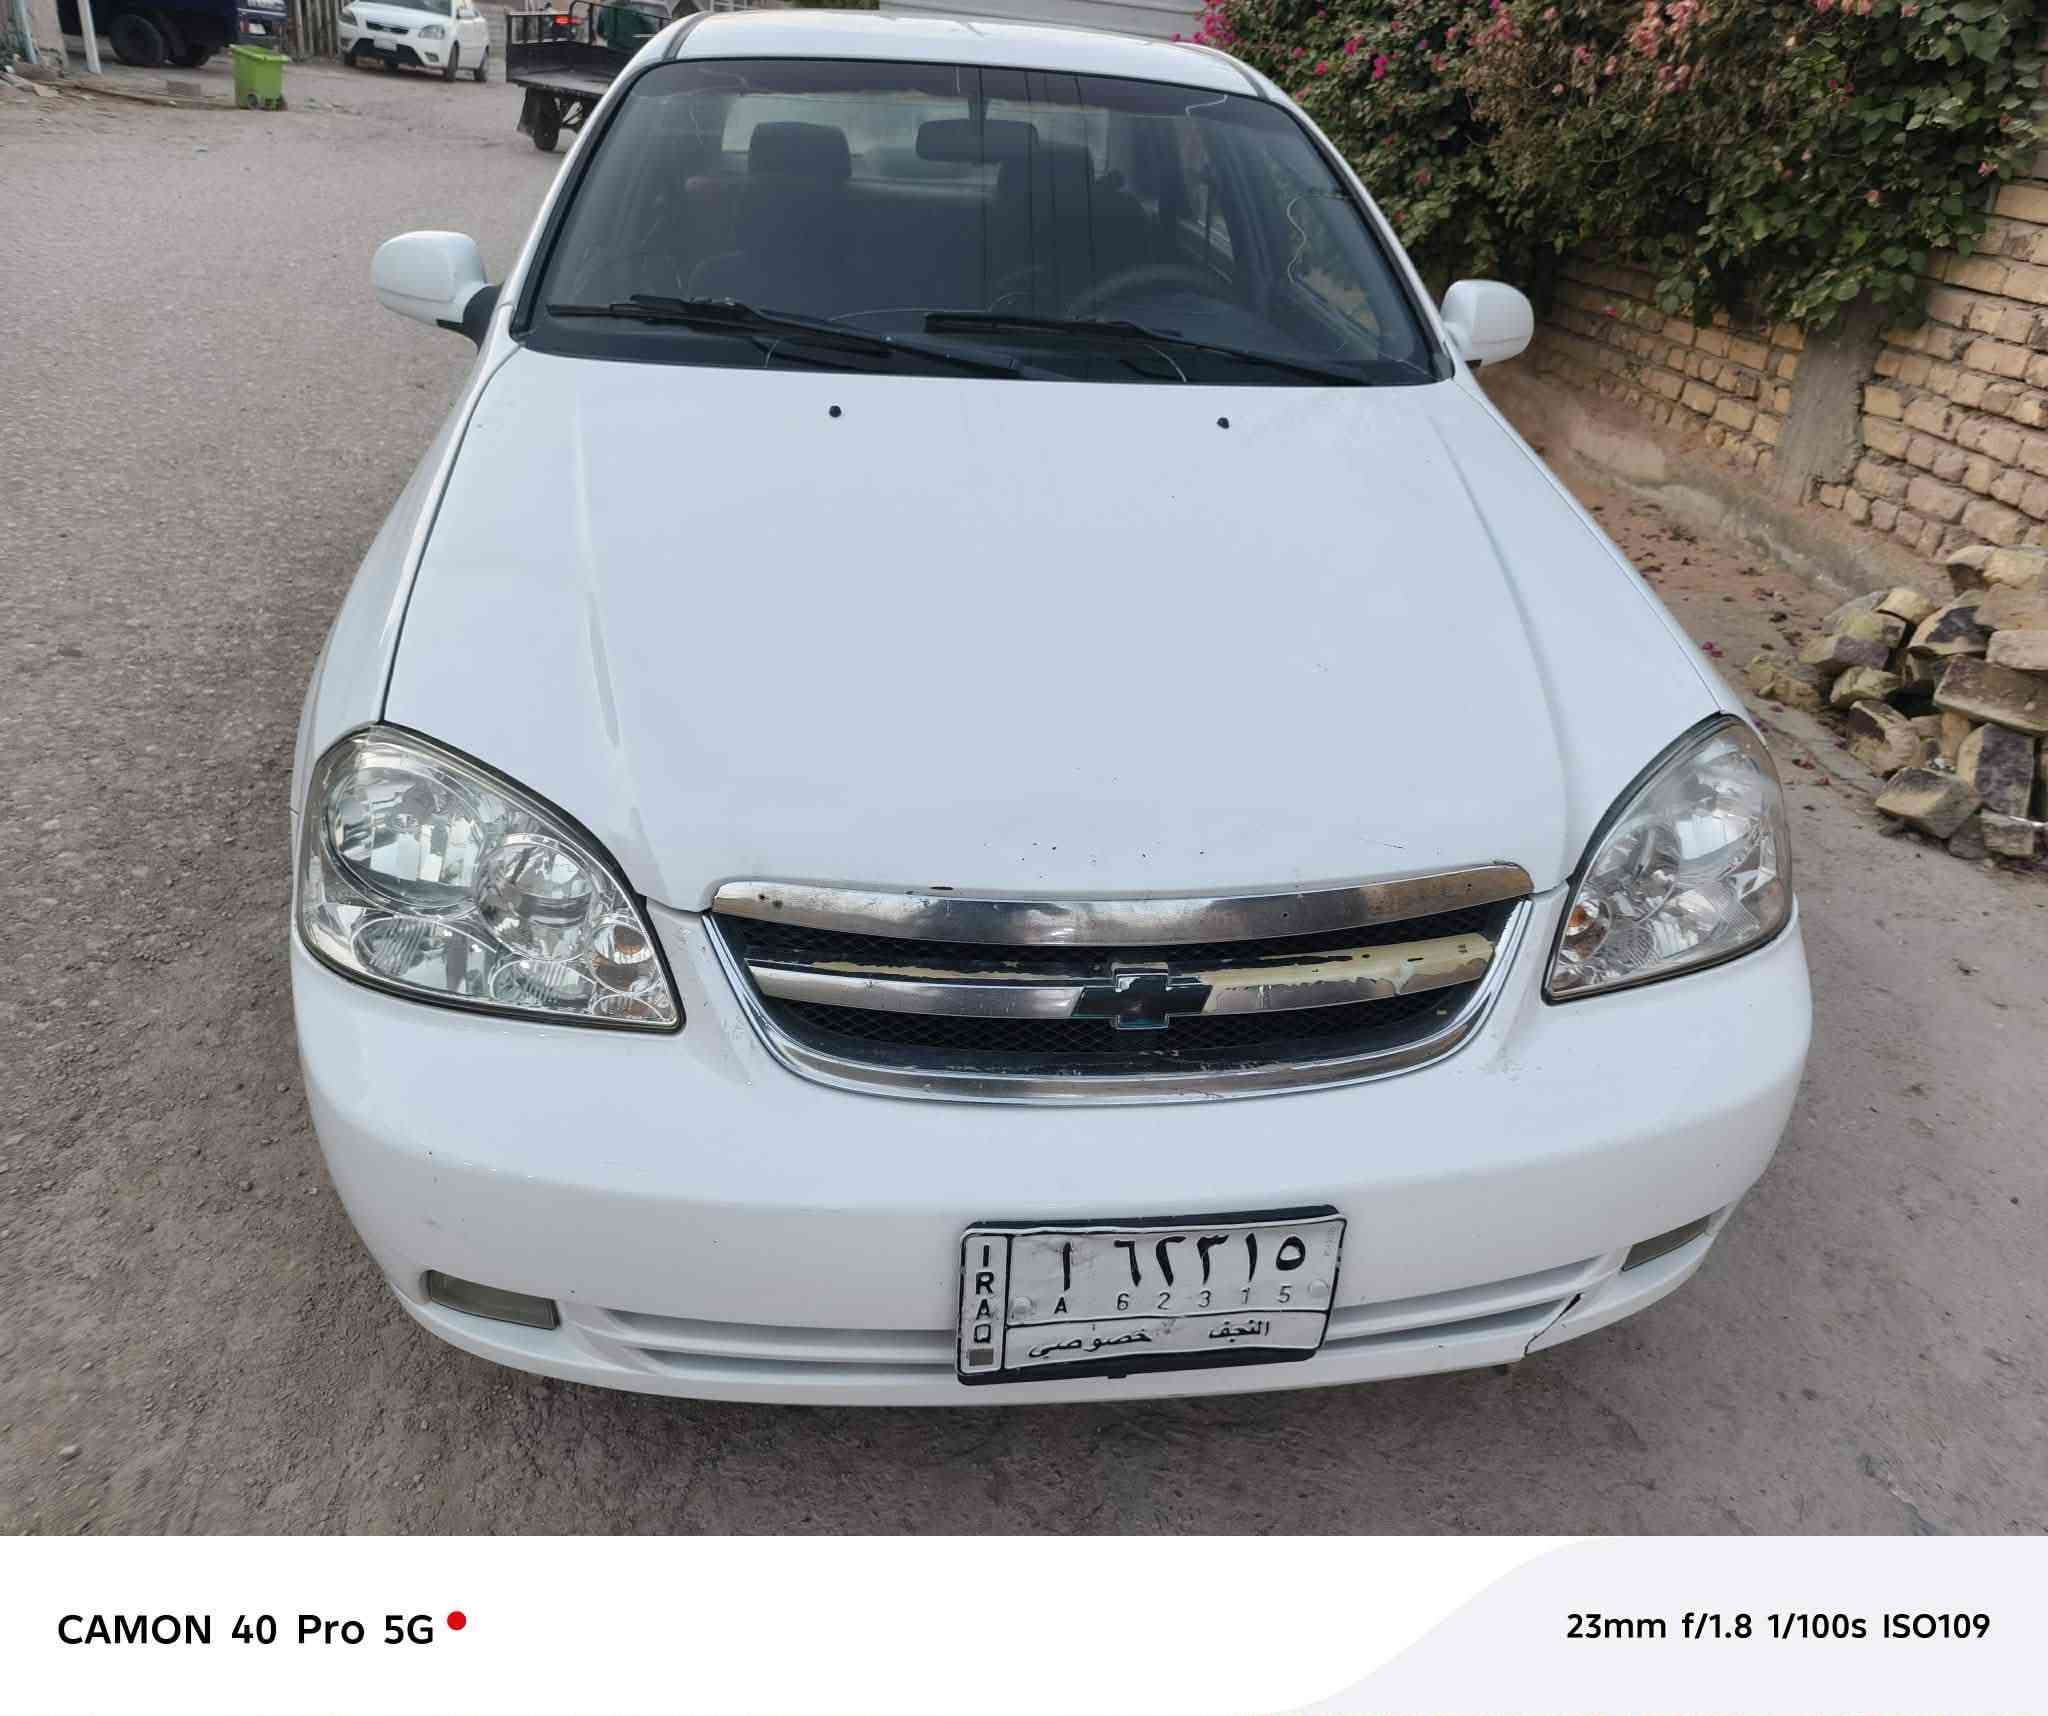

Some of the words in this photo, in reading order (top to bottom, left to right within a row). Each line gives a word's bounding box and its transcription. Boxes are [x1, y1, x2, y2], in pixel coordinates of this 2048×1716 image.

[973, 1244, 995, 1345] IRAQ
[1053, 1297, 1068, 1315] A
[1028, 1328, 1152, 1360] خصوصي
[1208, 1320, 1270, 1343] النجف
